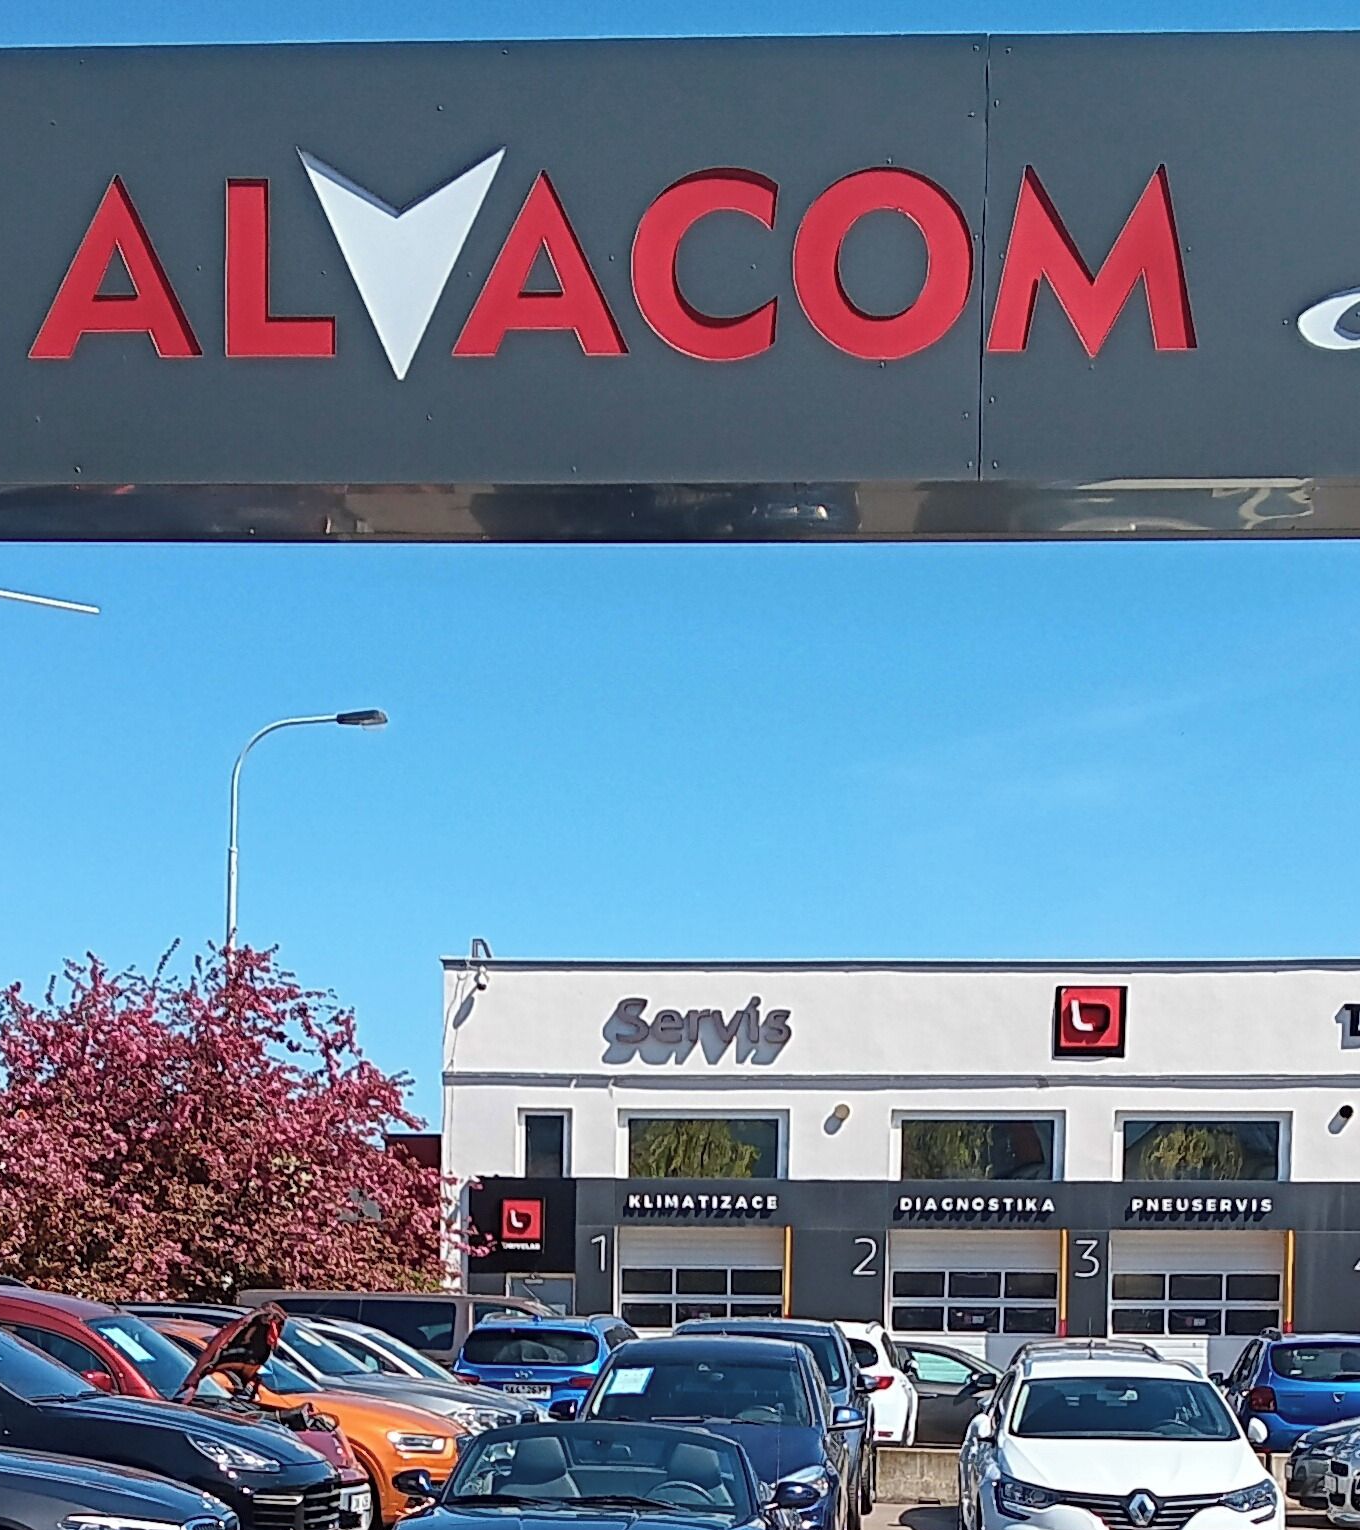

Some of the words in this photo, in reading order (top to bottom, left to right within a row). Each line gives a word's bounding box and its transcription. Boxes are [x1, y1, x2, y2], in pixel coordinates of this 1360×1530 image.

[27, 146, 1197, 381] ALVACOM
[614, 996, 792, 1045] Servis
[628, 1194, 778, 1210] KLIMATIZACE
[899, 1197, 1056, 1212] DIAGNOSTIKA
[1131, 1198, 1273, 1213] PNEUSERVIS
[591, 1234, 606, 1272] 1
[852, 1237, 878, 1276] 2
[1074, 1239, 1100, 1278] 3
